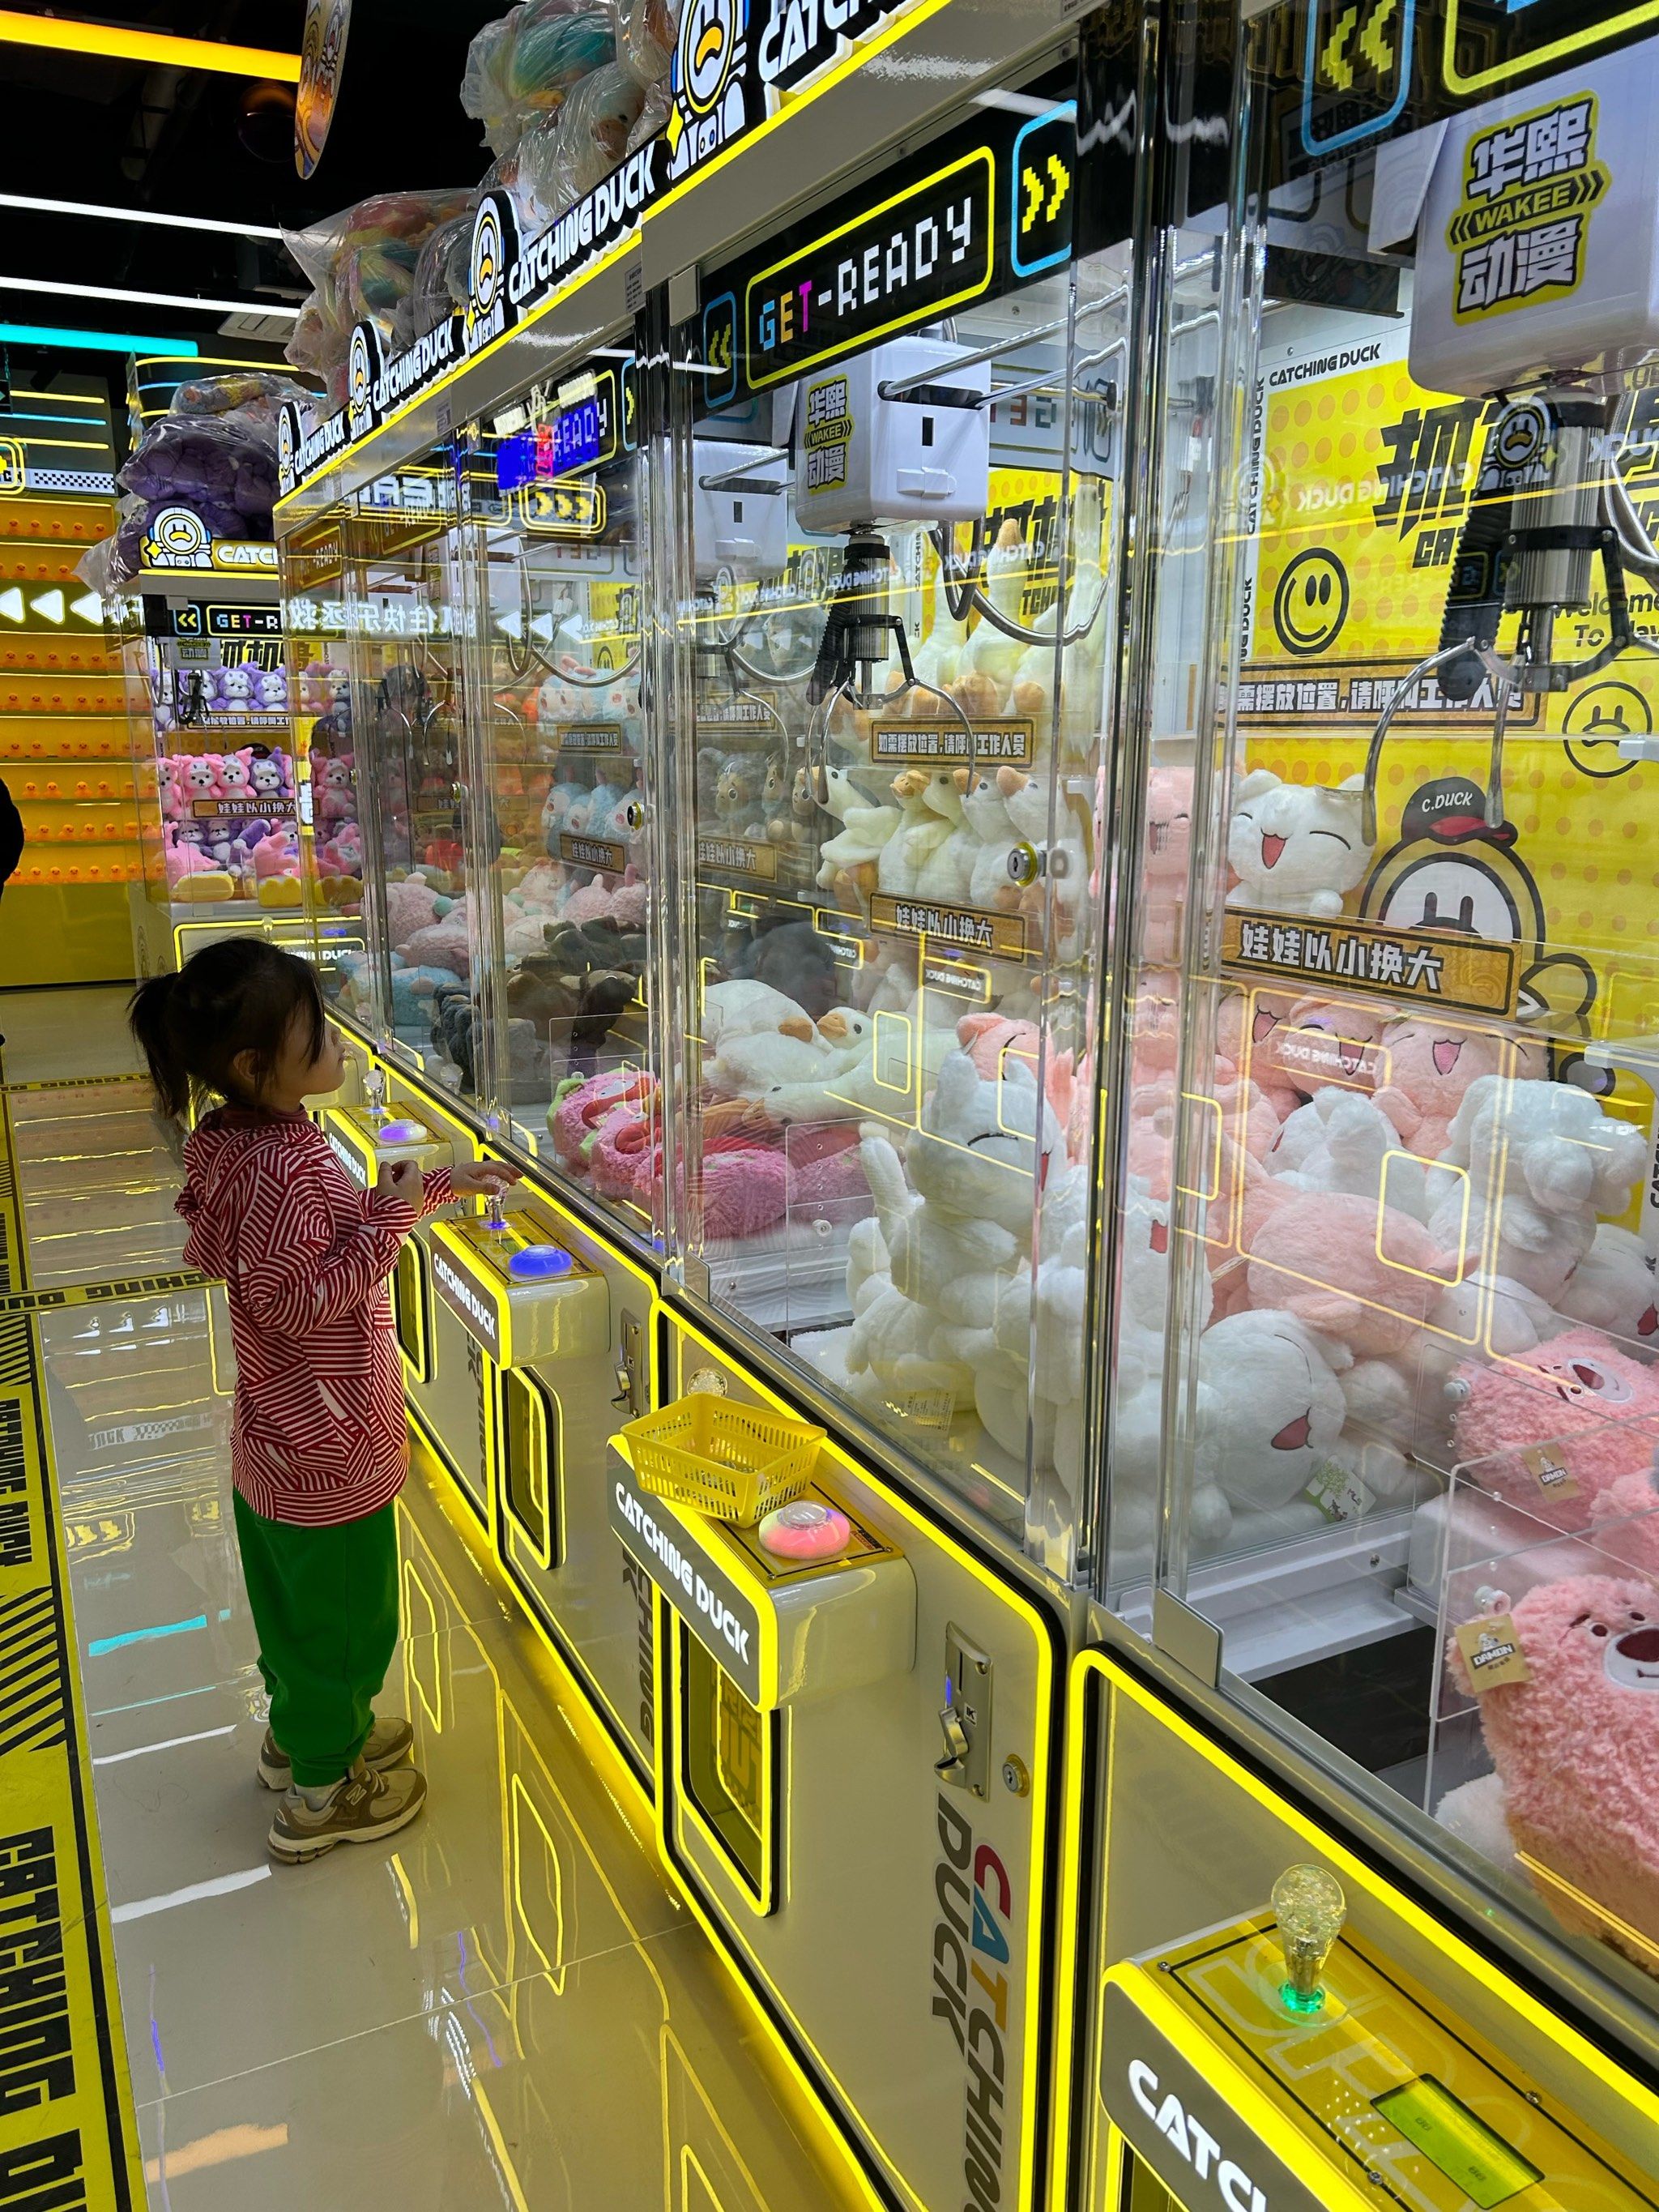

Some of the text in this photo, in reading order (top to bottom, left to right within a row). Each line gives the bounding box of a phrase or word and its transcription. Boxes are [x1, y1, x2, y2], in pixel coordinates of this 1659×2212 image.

[1468, 100, 1593, 201] 华熙
[509, 195, 592, 305] CATCHING
[595, 139, 655, 237] DUCK
[1475, 181, 1570, 232] WAKEE
[758, 197, 973, 351] GET-READY
[1458, 215, 1583, 313] 动漫
[373, 318, 455, 411] CATCHING DUCK
[1269, 343, 1381, 386] CATCHING DUCK
[808, 380, 847, 427] 华熙
[811, 425, 842, 444] WAKEE
[294, 412, 346, 475] CATCHING DUCK
[808, 443, 846, 489] 动漫
[1247, 376, 1265, 535] CATCHING DUCK
[1574, 624, 1605, 647] To
[1421, 790, 1474, 813] C.DUCK
[896, 904, 993, 949] 娃娃以小换大
[1241, 922, 1444, 992] 娃娃以小换大
[434, 1253, 496, 1340] CATCHING DUCK
[616, 1482, 693, 1598] CATCHING
[696, 1574, 749, 1666] DUCK
[1473, 1644, 1514, 1667] DAMON
[931, 1791, 972, 2058] DUCK
[964, 1844, 1012, 2212] CATCHIN
